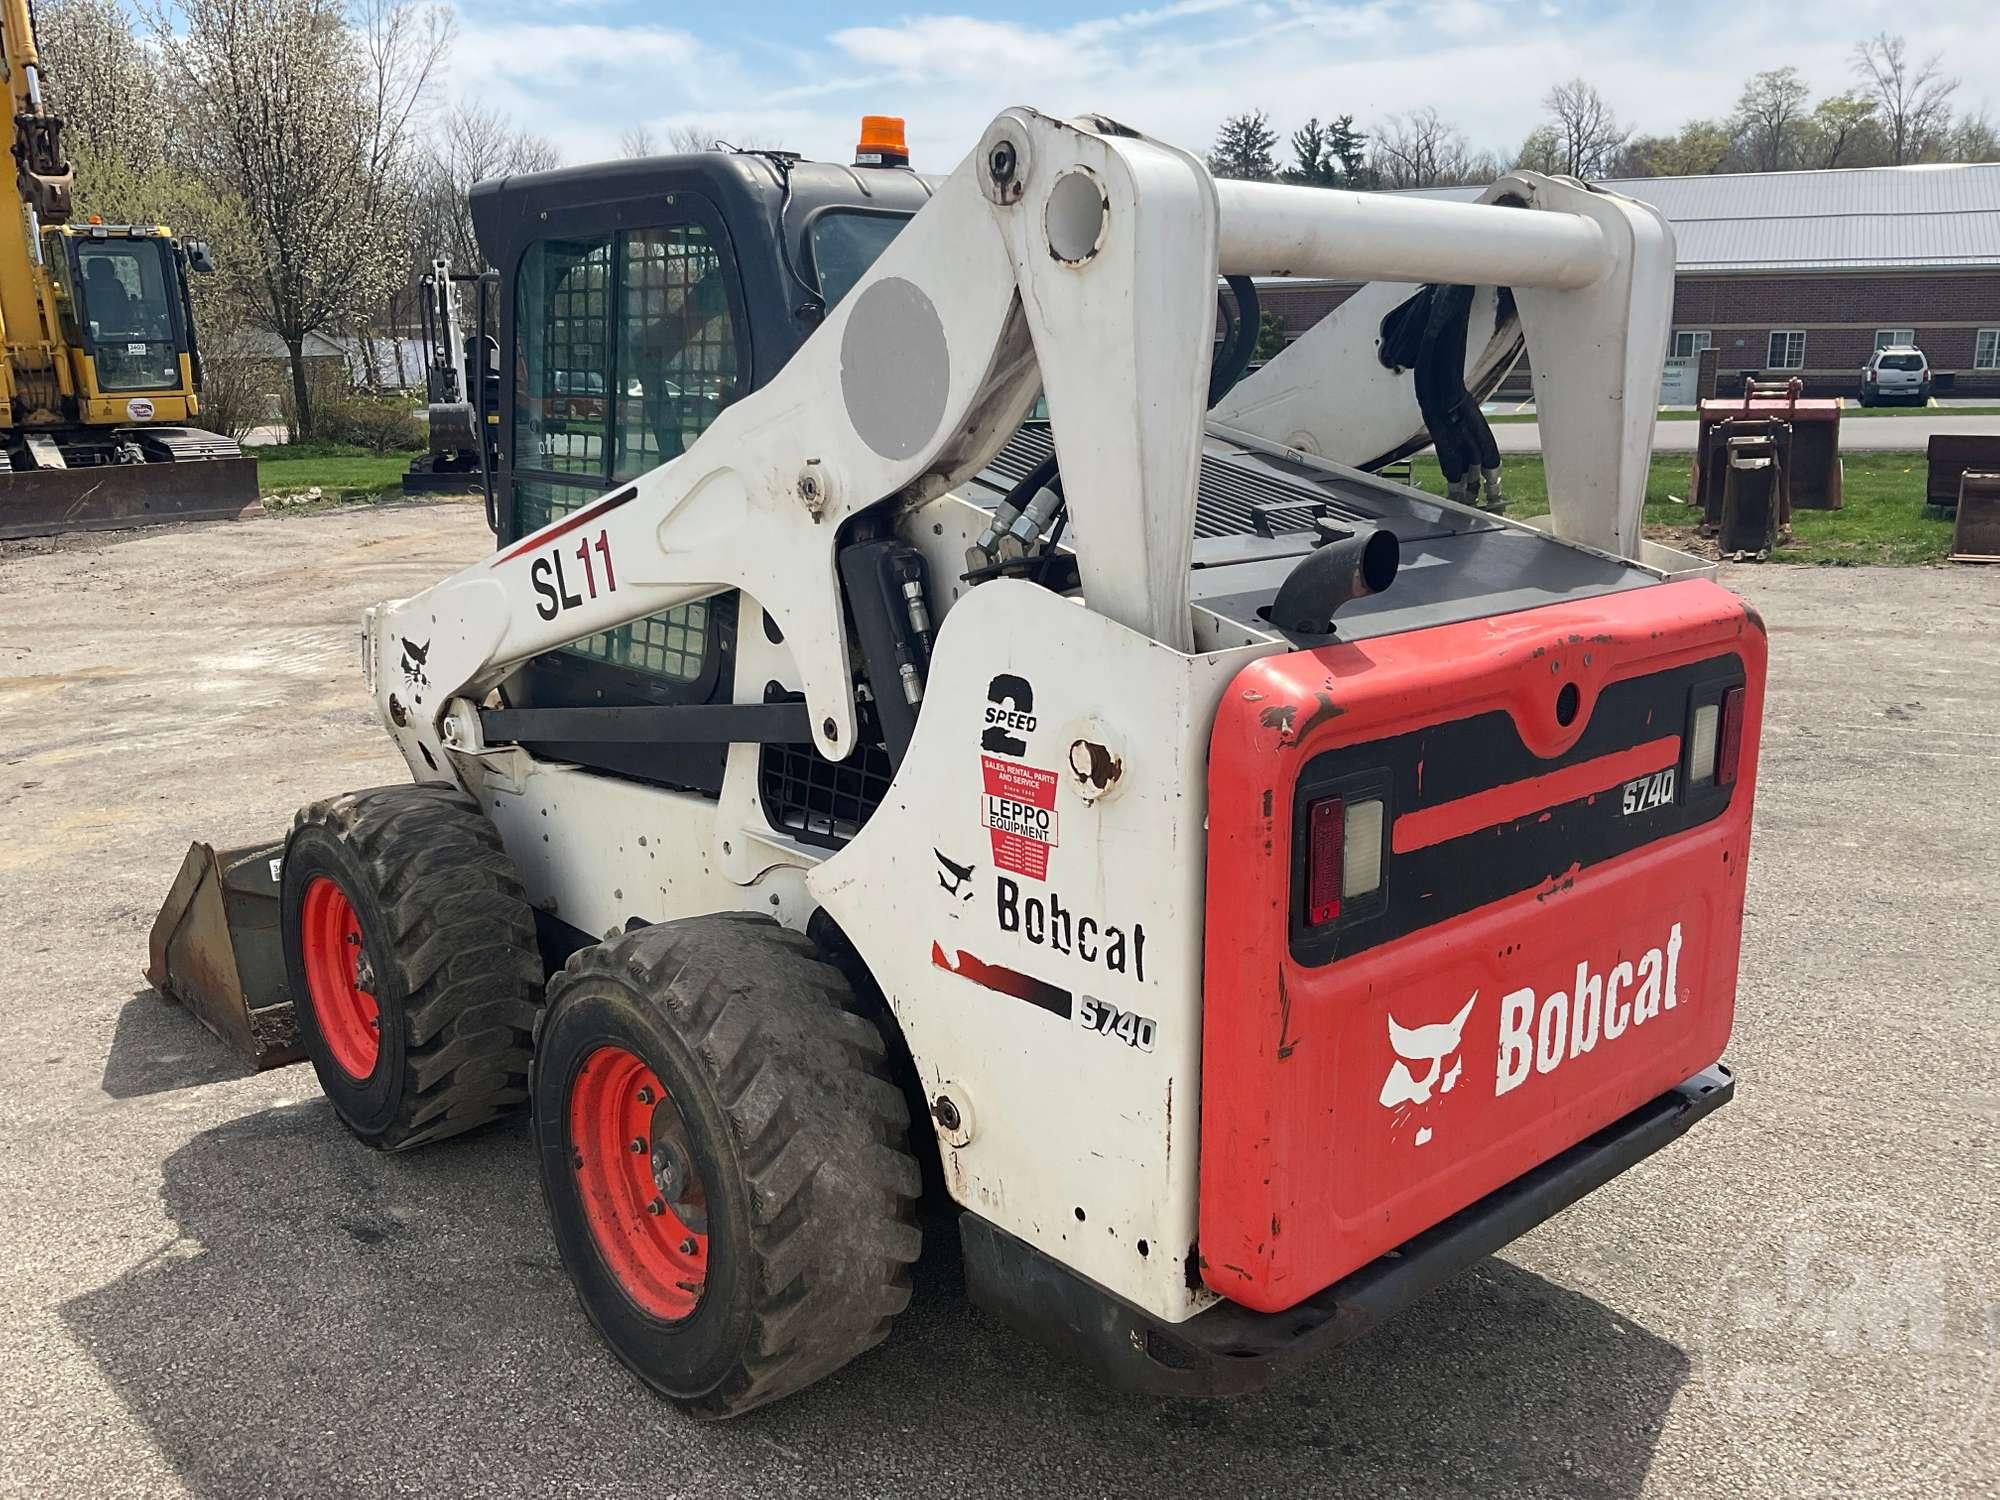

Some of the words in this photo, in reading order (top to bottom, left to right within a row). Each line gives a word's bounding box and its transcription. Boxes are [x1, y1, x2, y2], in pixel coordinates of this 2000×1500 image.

[531, 529, 616, 621] SL11
[985, 707, 1037, 732] SPEED
[984, 761, 1006, 773] SALES,
[1007, 766, 1033, 779] RENTAL,
[1034, 773, 1055, 784] PARTS
[999, 773, 1012, 781] AND
[1013, 775, 1040, 789] SERVICE
[1623, 769, 1674, 816] S740
[990, 796, 1050, 829] LEPPO
[990, 815, 1050, 841] EQUIPMENT
[997, 876, 1146, 982] Bobcat
[1080, 995, 1156, 1053] S740
[1495, 922, 1683, 1096] Bobcat
